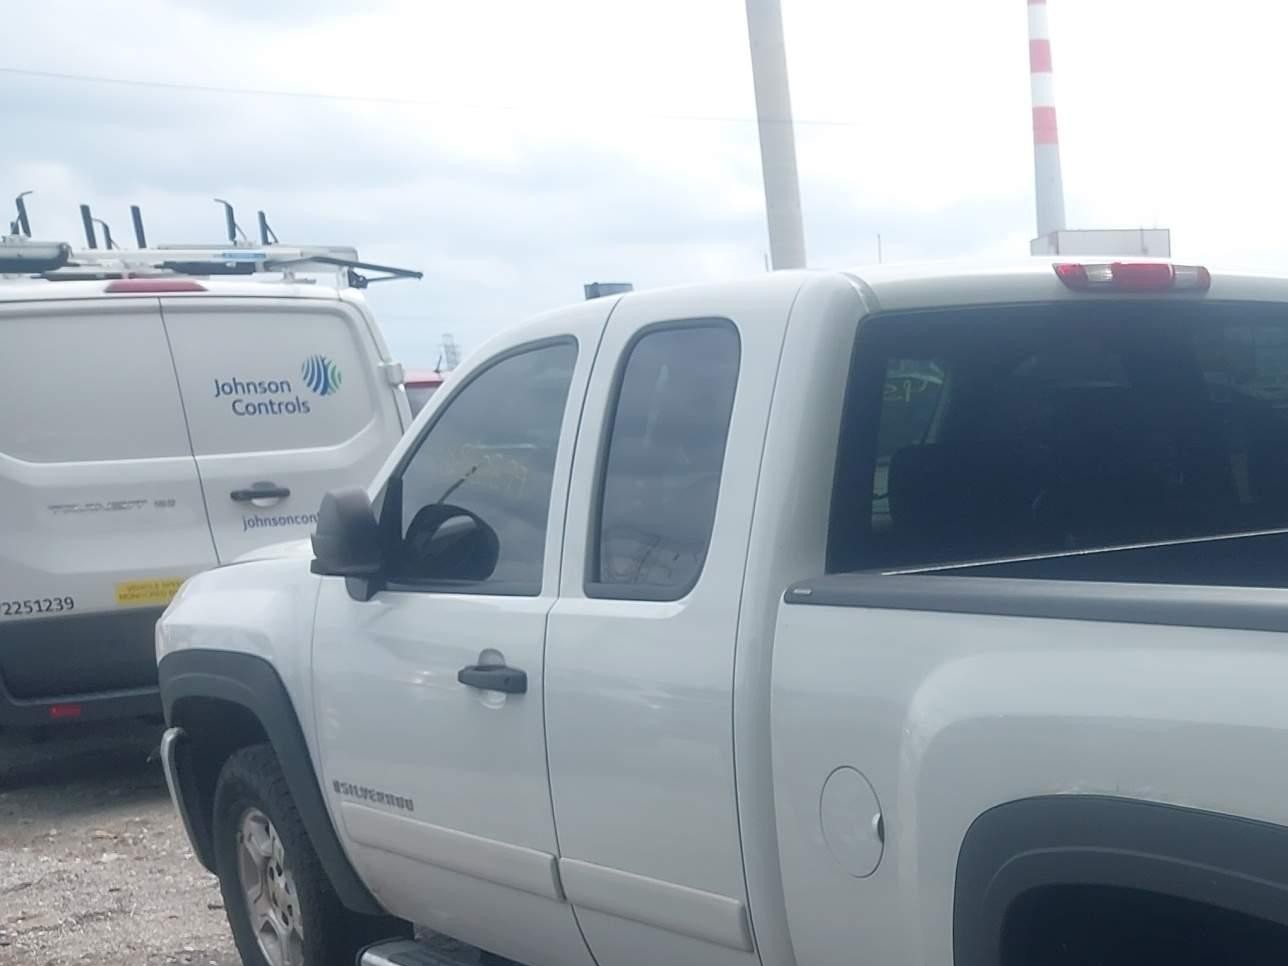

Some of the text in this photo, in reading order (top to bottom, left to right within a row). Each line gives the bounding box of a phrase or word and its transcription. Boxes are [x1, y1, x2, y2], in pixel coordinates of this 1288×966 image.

[214, 377, 292, 398] Johnson
[232, 396, 311, 416] Controls
[0, 596, 75, 616] 2251239
